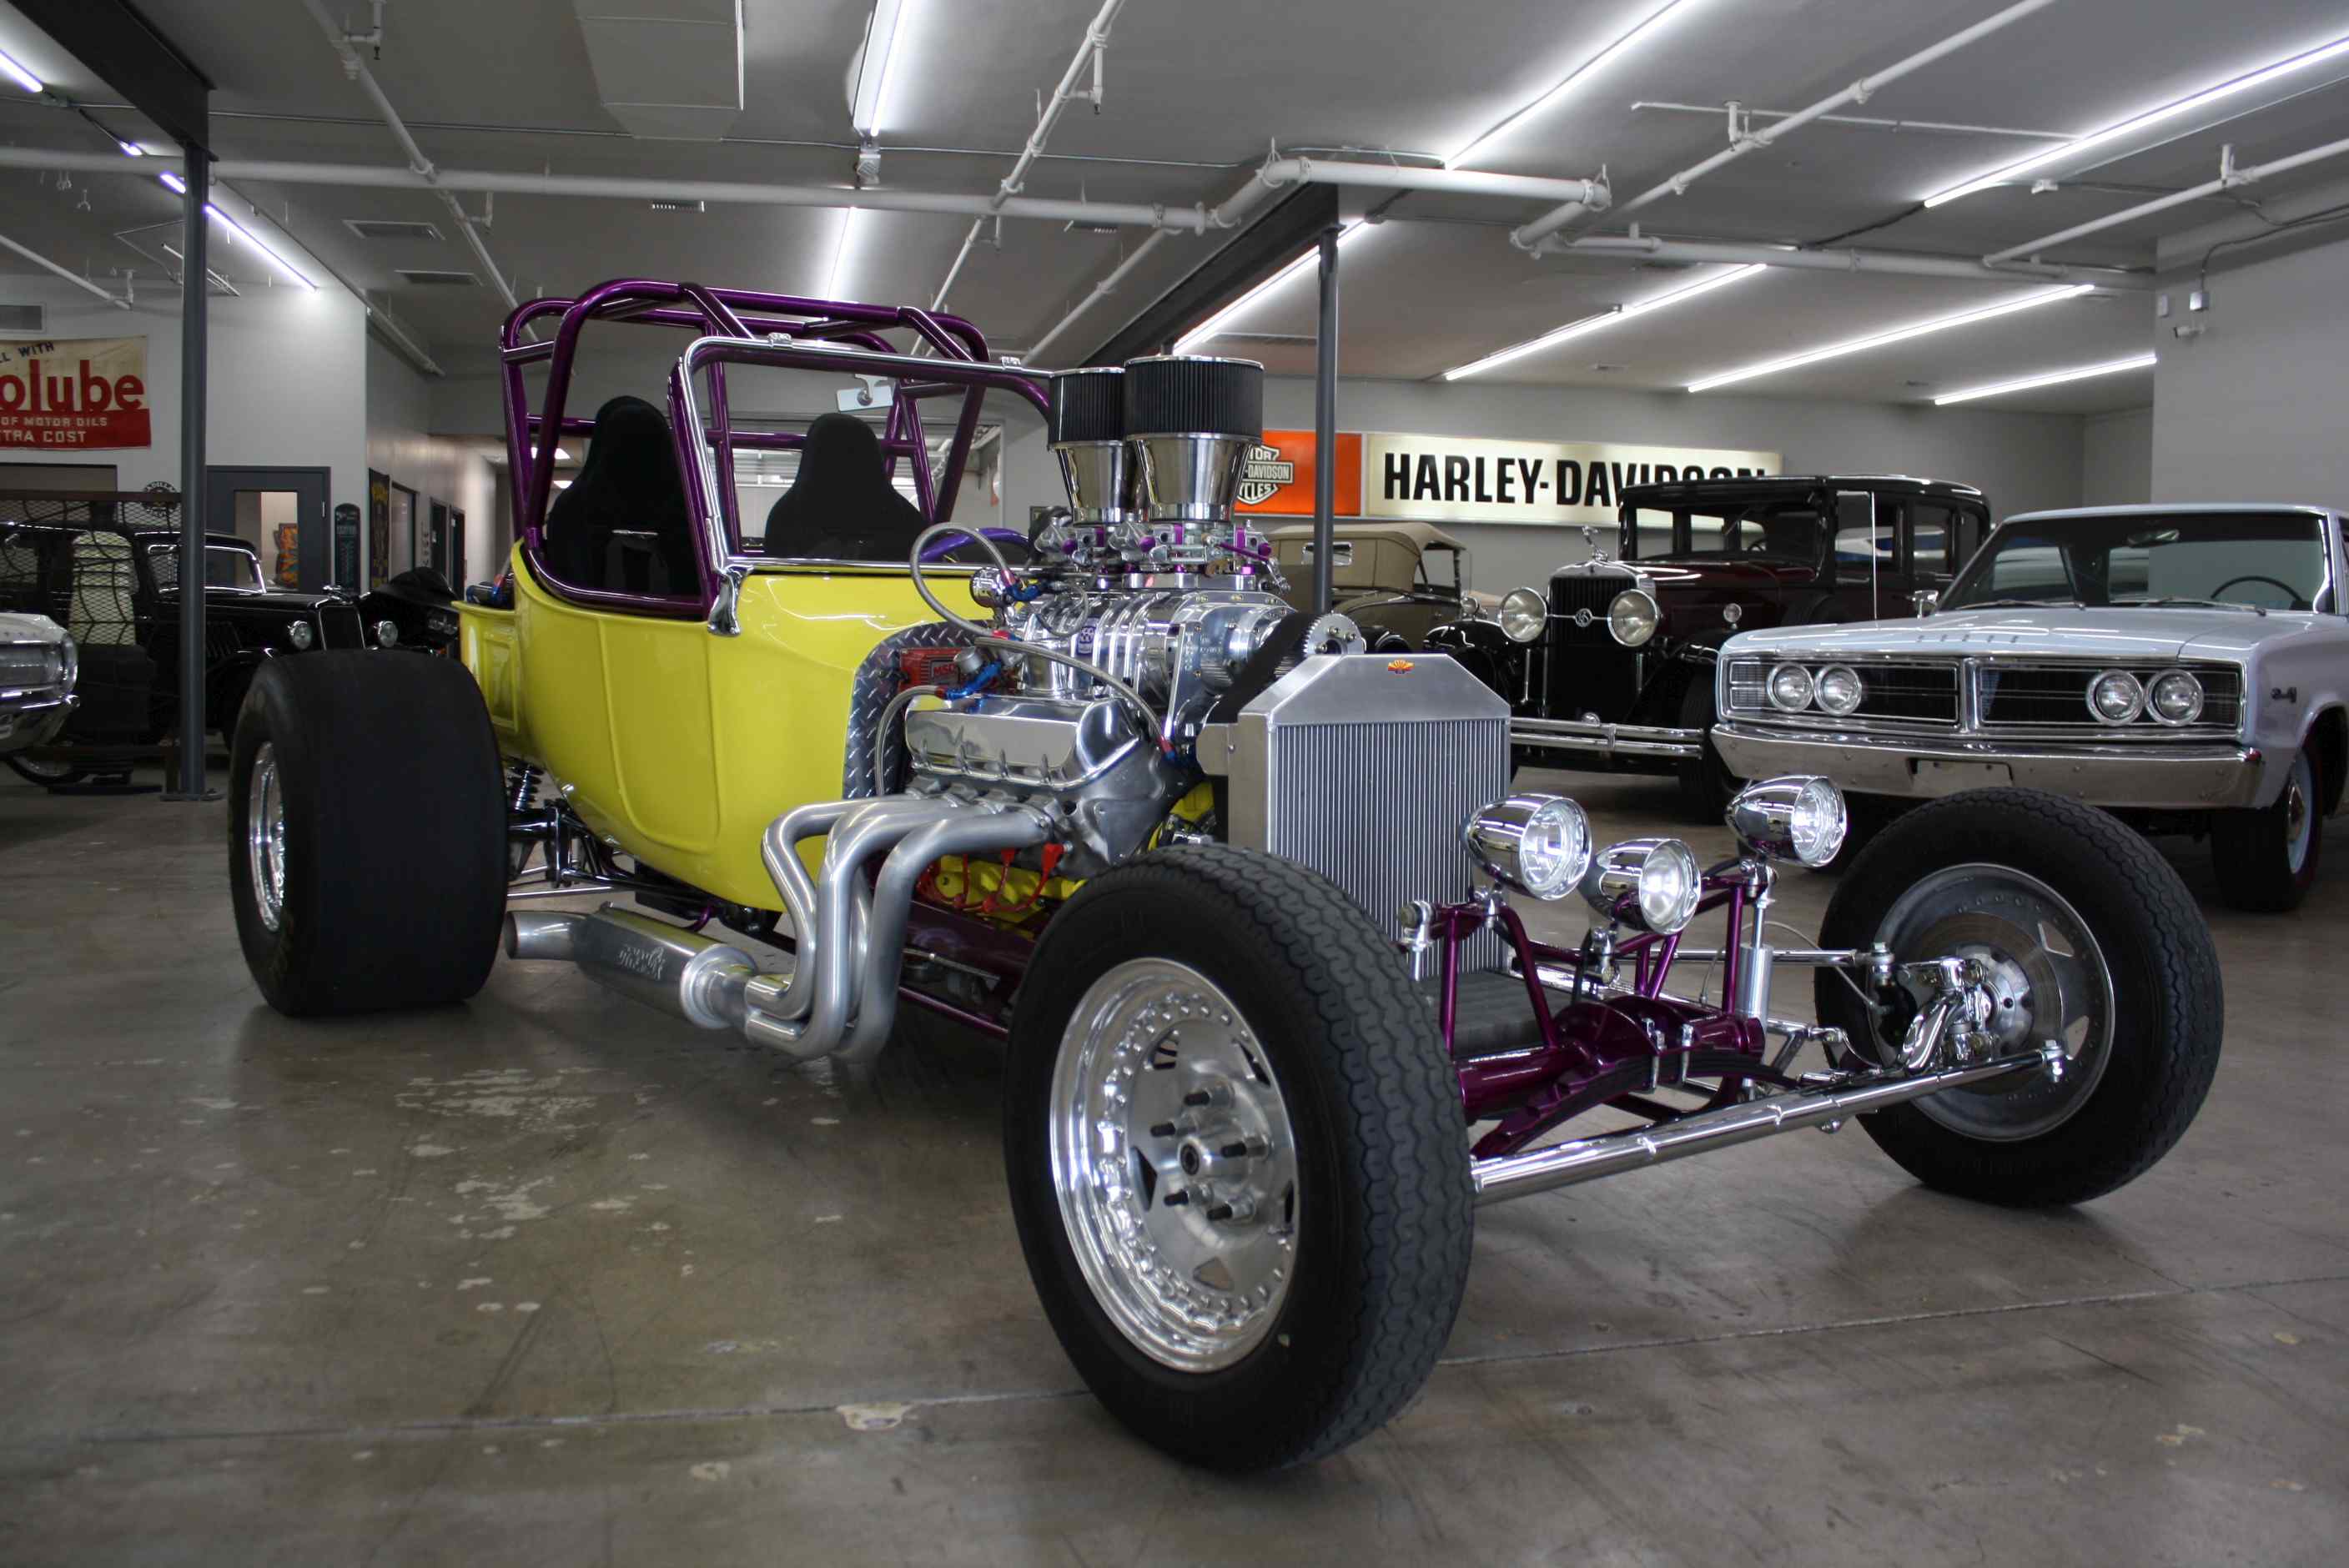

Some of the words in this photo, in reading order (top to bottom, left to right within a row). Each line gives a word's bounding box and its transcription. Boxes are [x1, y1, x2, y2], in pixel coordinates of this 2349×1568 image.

[18, 341, 54, 357] WITH
[1, 417, 18, 426] OF
[24, 417, 71, 426] MOTOR
[77, 417, 108, 426] OILS
[43, 430, 86, 442] COST
